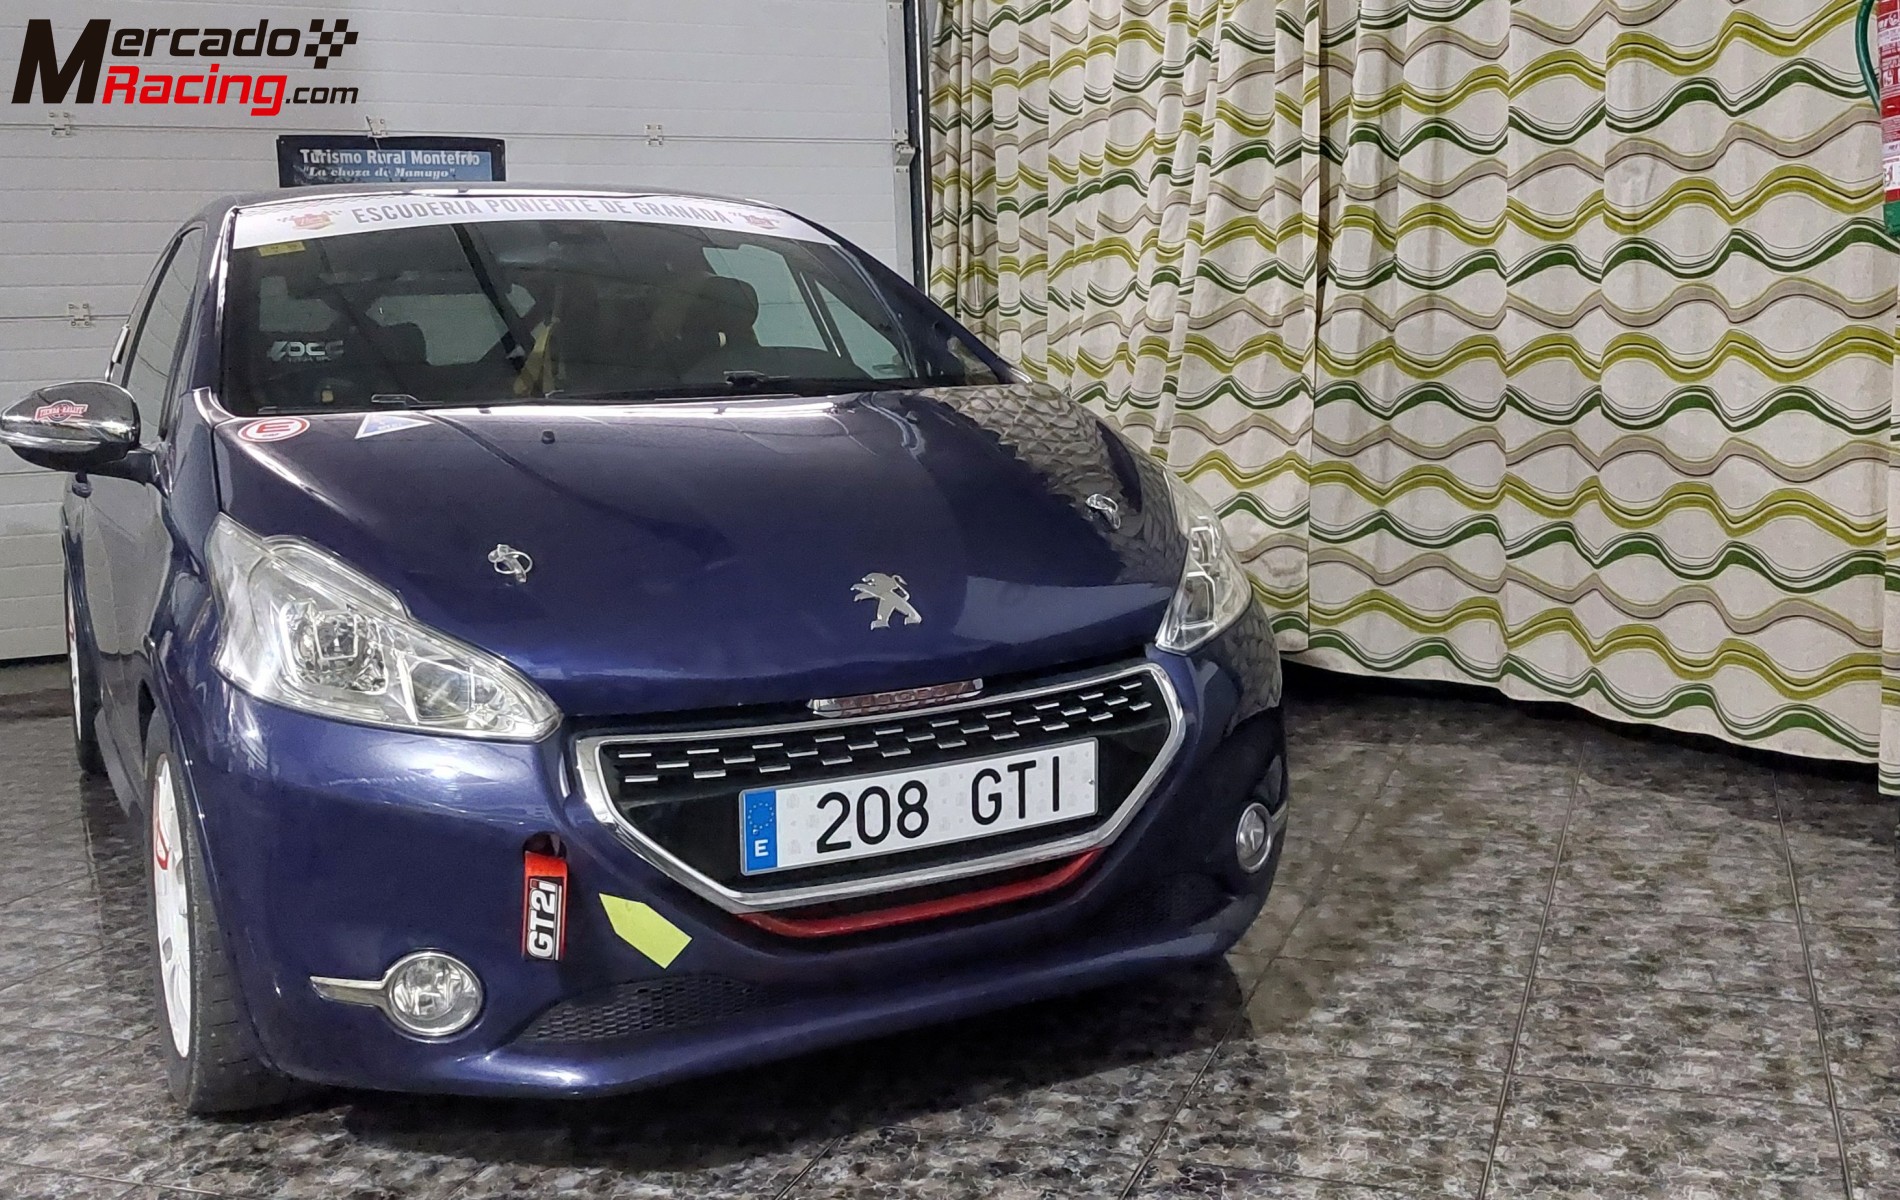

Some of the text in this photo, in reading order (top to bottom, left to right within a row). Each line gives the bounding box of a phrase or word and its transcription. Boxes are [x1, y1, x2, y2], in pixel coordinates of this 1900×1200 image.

[300, 149, 362, 164] Turismo
[366, 150, 406, 164] Rural
[330, 167, 371, 177] choza
[351, 200, 482, 223] ESCUDERIA
[485, 198, 596, 214] PONIENTE
[599, 199, 632, 214] DE
[632, 201, 733, 224] GRANADA
[815, 756, 1060, 854] 208 GTI
[753, 839, 769, 858] E
